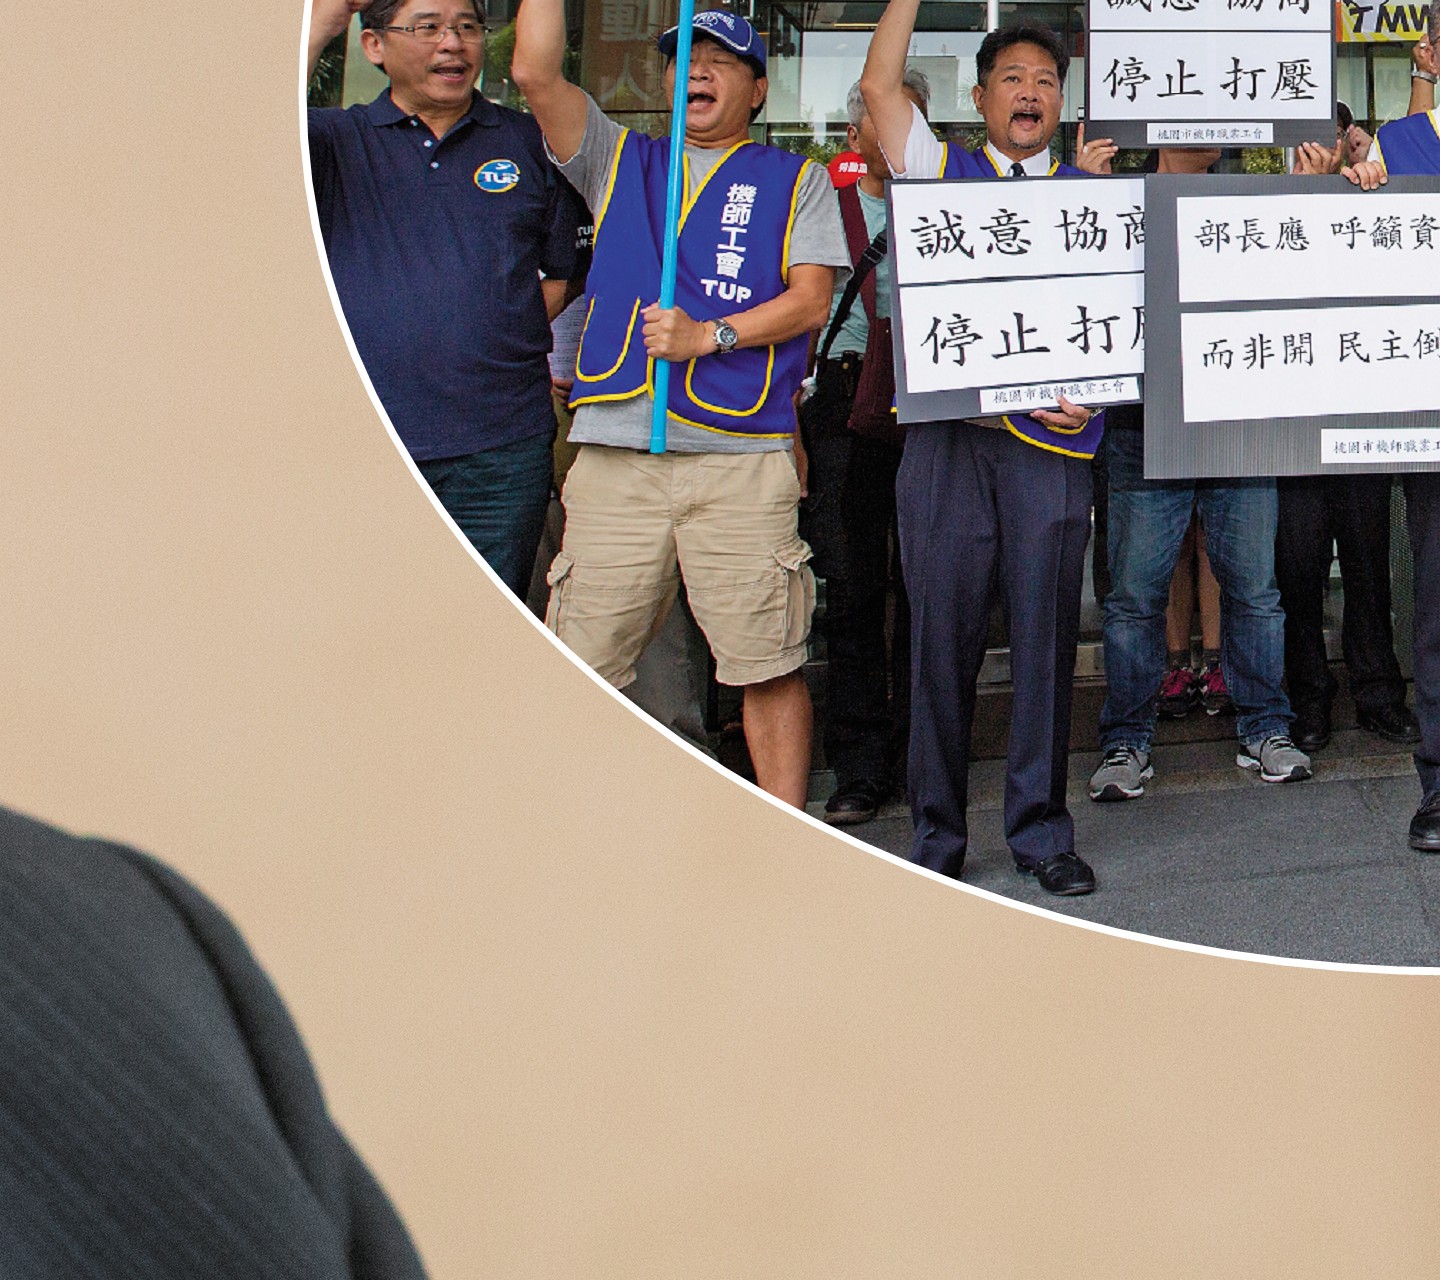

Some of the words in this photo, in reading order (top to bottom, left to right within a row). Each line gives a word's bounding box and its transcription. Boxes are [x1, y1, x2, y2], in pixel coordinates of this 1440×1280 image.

[1104, 57, 1317, 102] 停止打壓
[480, 171, 520, 184] TUP
[715, 182, 758, 280] 機師工會
[700, 278, 752, 304] TUP
[921, 306, 1142, 366] 停止打
